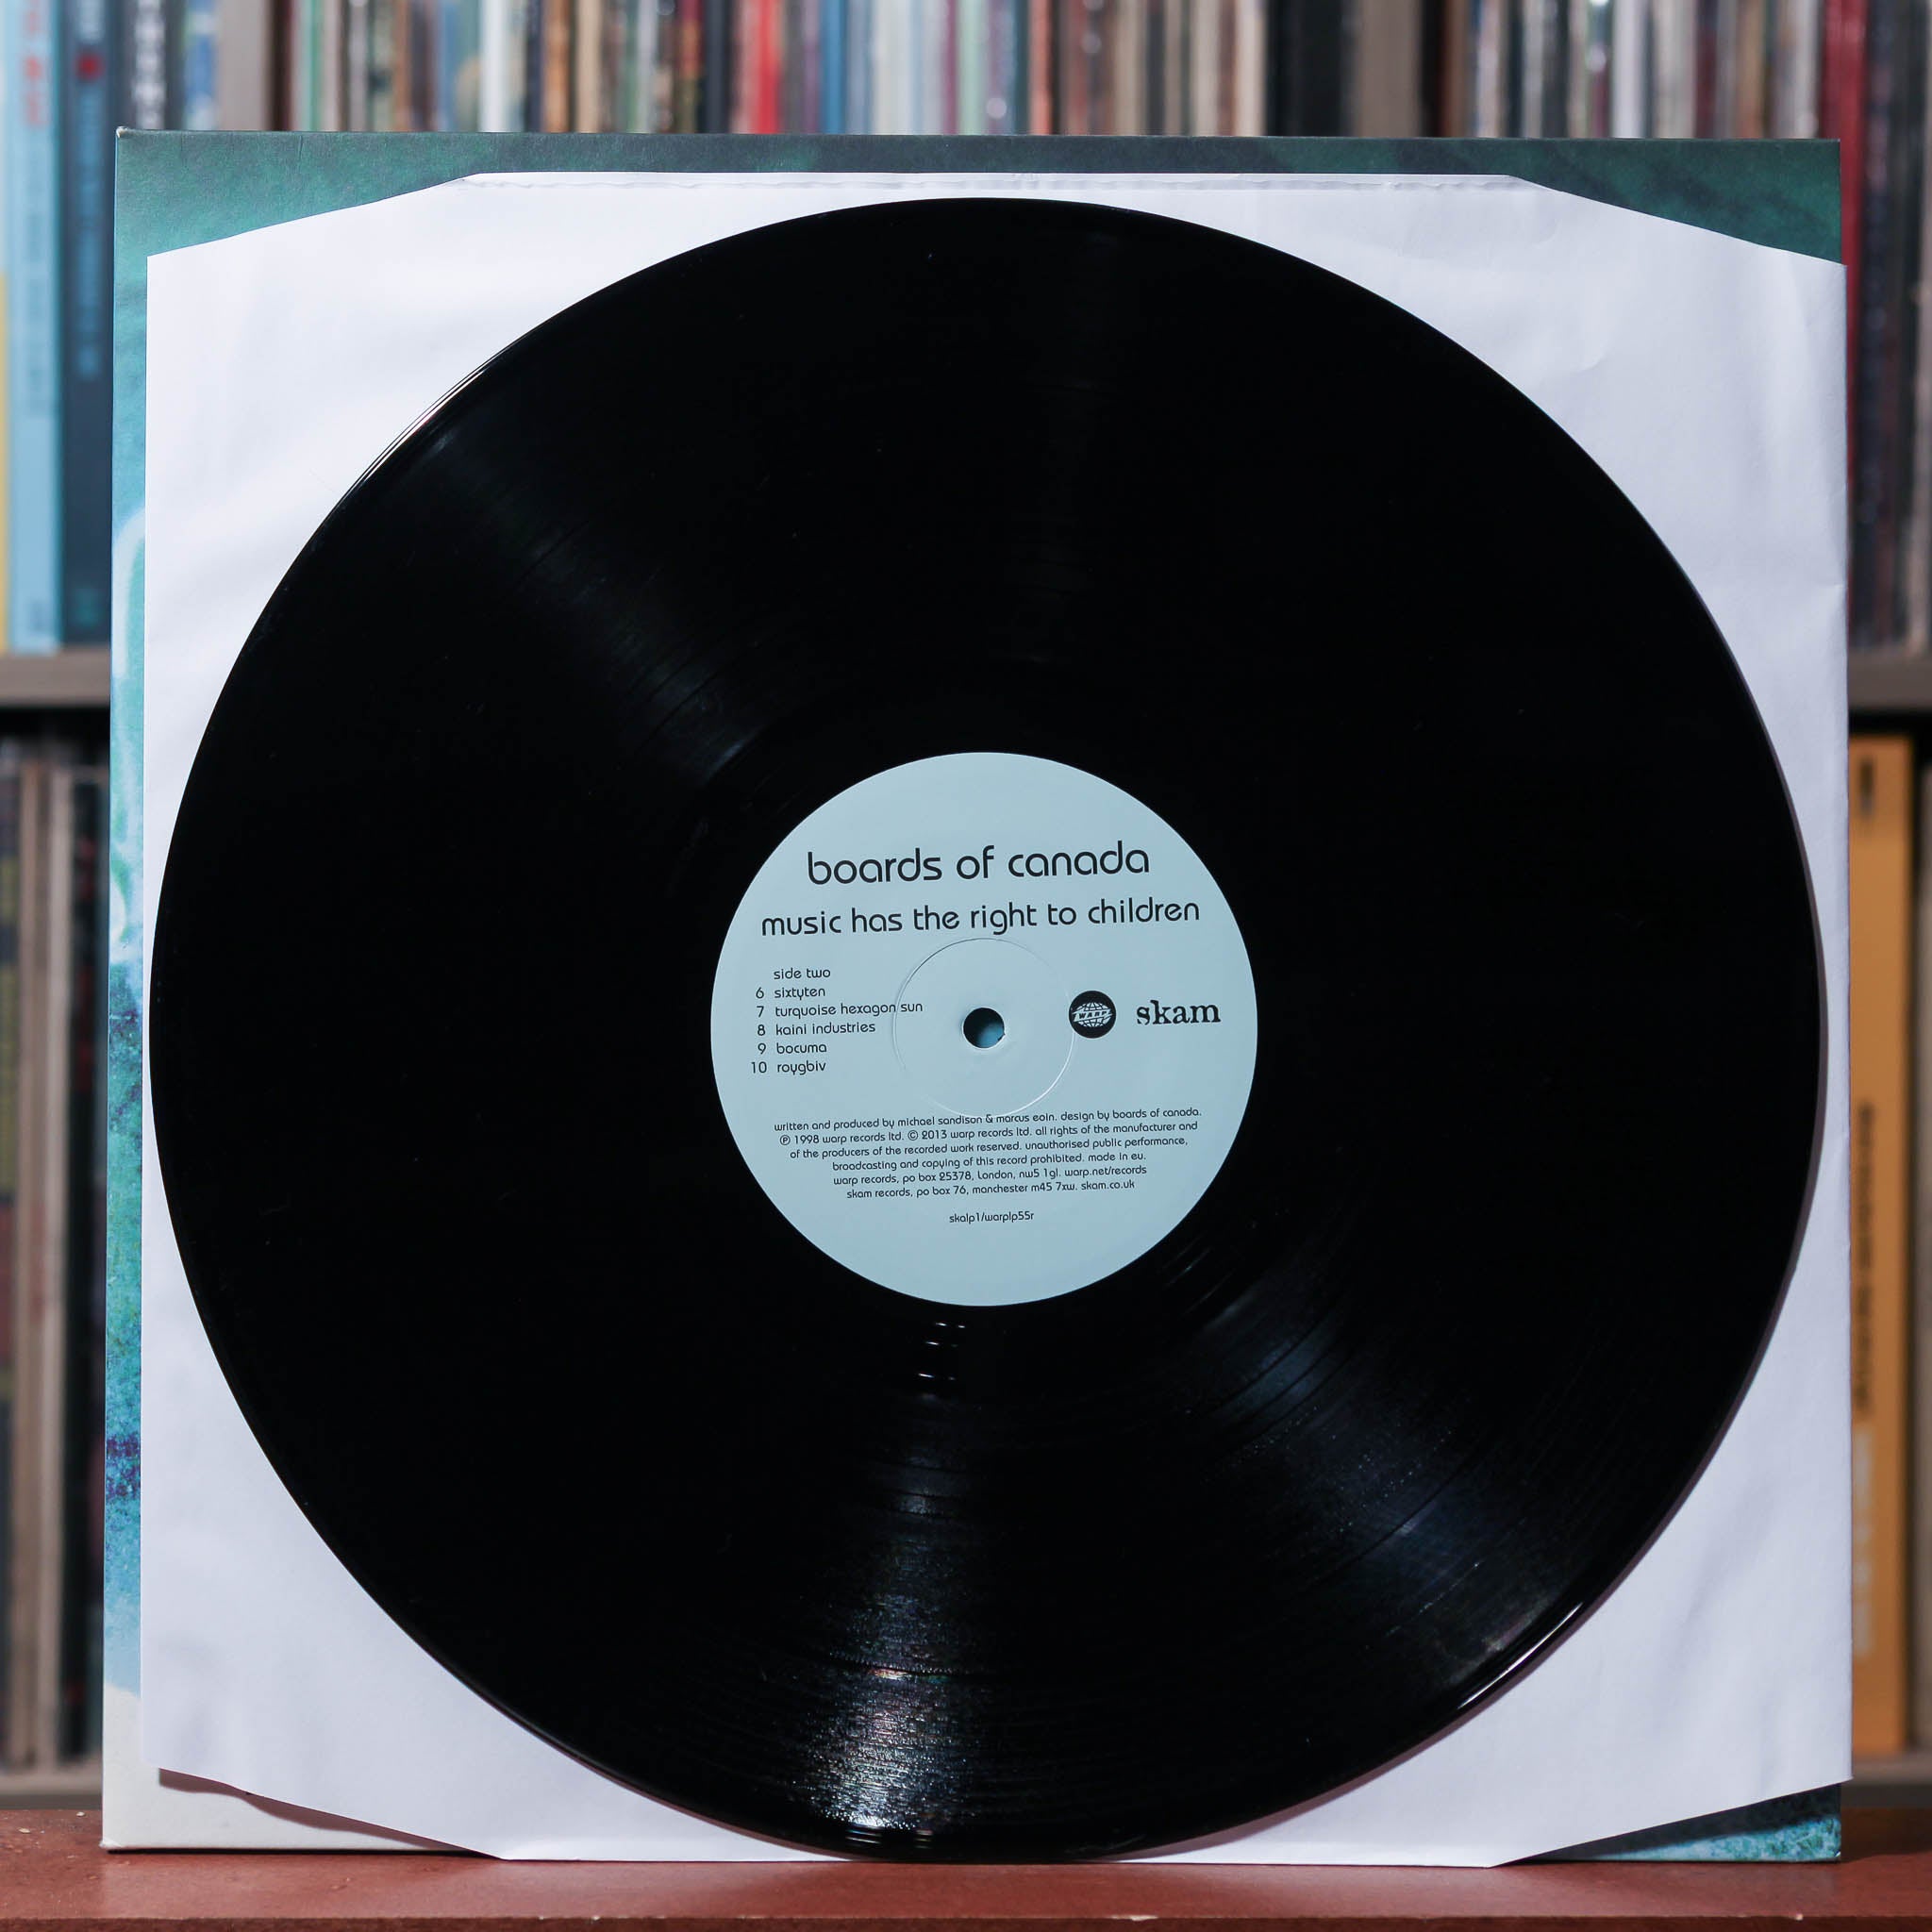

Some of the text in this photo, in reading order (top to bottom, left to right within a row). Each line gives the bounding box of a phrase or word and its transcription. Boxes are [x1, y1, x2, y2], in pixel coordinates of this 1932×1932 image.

[807, 840, 1150, 886] boards of canada
[761, 895, 1200, 937] music has the right to children
[773, 966, 831, 980] side two
[755, 986, 826, 1002] 6 sixtyten
[756, 1002, 924, 1020] 7 turquoise hexagon sun
[1136, 999, 1222, 1025] skam
[757, 1021, 876, 1037] 8 kaini industries
[757, 1041, 827, 1056] 9 bocuma
[750, 1059, 827, 1076] 10 roygbiv
[774, 1106, 1202, 1132] written and produced by michael sandison & marcus eoin. design by boards of canada.
[794, 1134, 820, 1145] 1998
[822, 1135, 847, 1145] warp
[849, 1131, 886, 1143] records
[888, 1131, 905, 1141] ltd.
[921, 1129, 948, 1141] 2013
[950, 1130, 975, 1141] warp
[977, 1126, 1014, 1138] records
[1016, 1125, 1033, 1137] ltd.
[1035, 1125, 1047, 1136] all
[1049, 1124, 1078, 1138] rights
[1080, 1124, 1091, 1135] of
[1093, 1124, 1110, 1134] the
[1112, 1122, 1176, 1133] manufacturer
[1178, 1120, 1198, 1131] and
[790, 1136, 1189, 1160] of the producers of the recorded work reserved. unauthorised public performance,
[832, 1151, 1147, 1172] broadcasting and copying of this record prohibited. made in eu.
[833, 1176, 858, 1188] warp
[860, 1173, 900, 1185] records,
[902, 1174, 916, 1186] po
[918, 1172, 937, 1182] box
[939, 1170, 974, 1182] 25378,
[1018, 1168, 1041, 1178] nw5
[1064, 1164, 1148, 1179] warp.net/records
[846, 1178, 1135, 1199] skam records, po box 76, manchester m45 7xw. skam.co.uk
[949, 1210, 1035, 1225] skalp1/warplp55r
